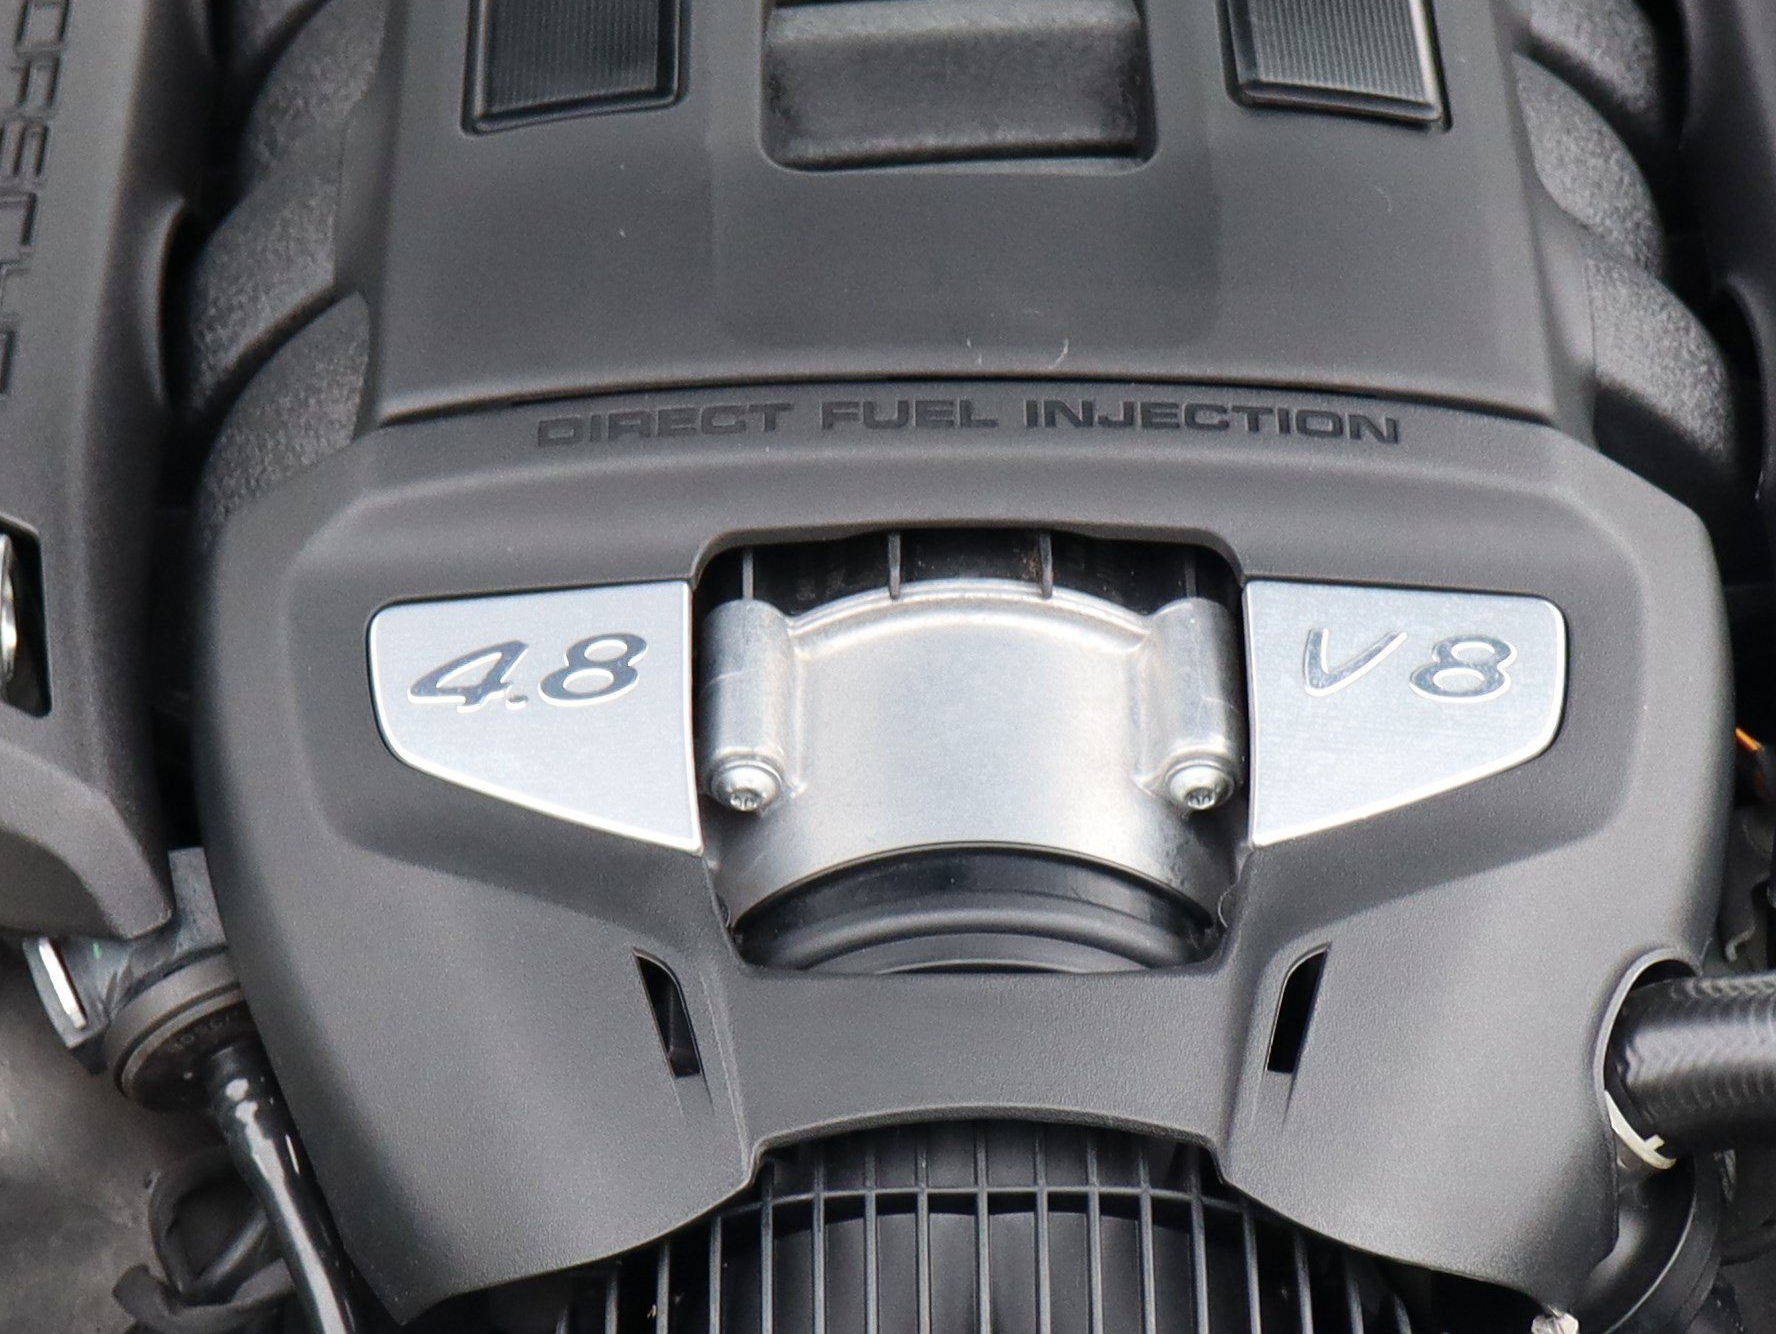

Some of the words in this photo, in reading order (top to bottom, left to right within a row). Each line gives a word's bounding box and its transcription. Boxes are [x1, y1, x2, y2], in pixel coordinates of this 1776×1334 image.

[537, 401, 792, 448] DIRECT
[822, 399, 999, 431] FUEL
[1025, 399, 1400, 444] INJECTION
[408, 632, 649, 711] 4.8
[1303, 629, 1517, 703] V8
